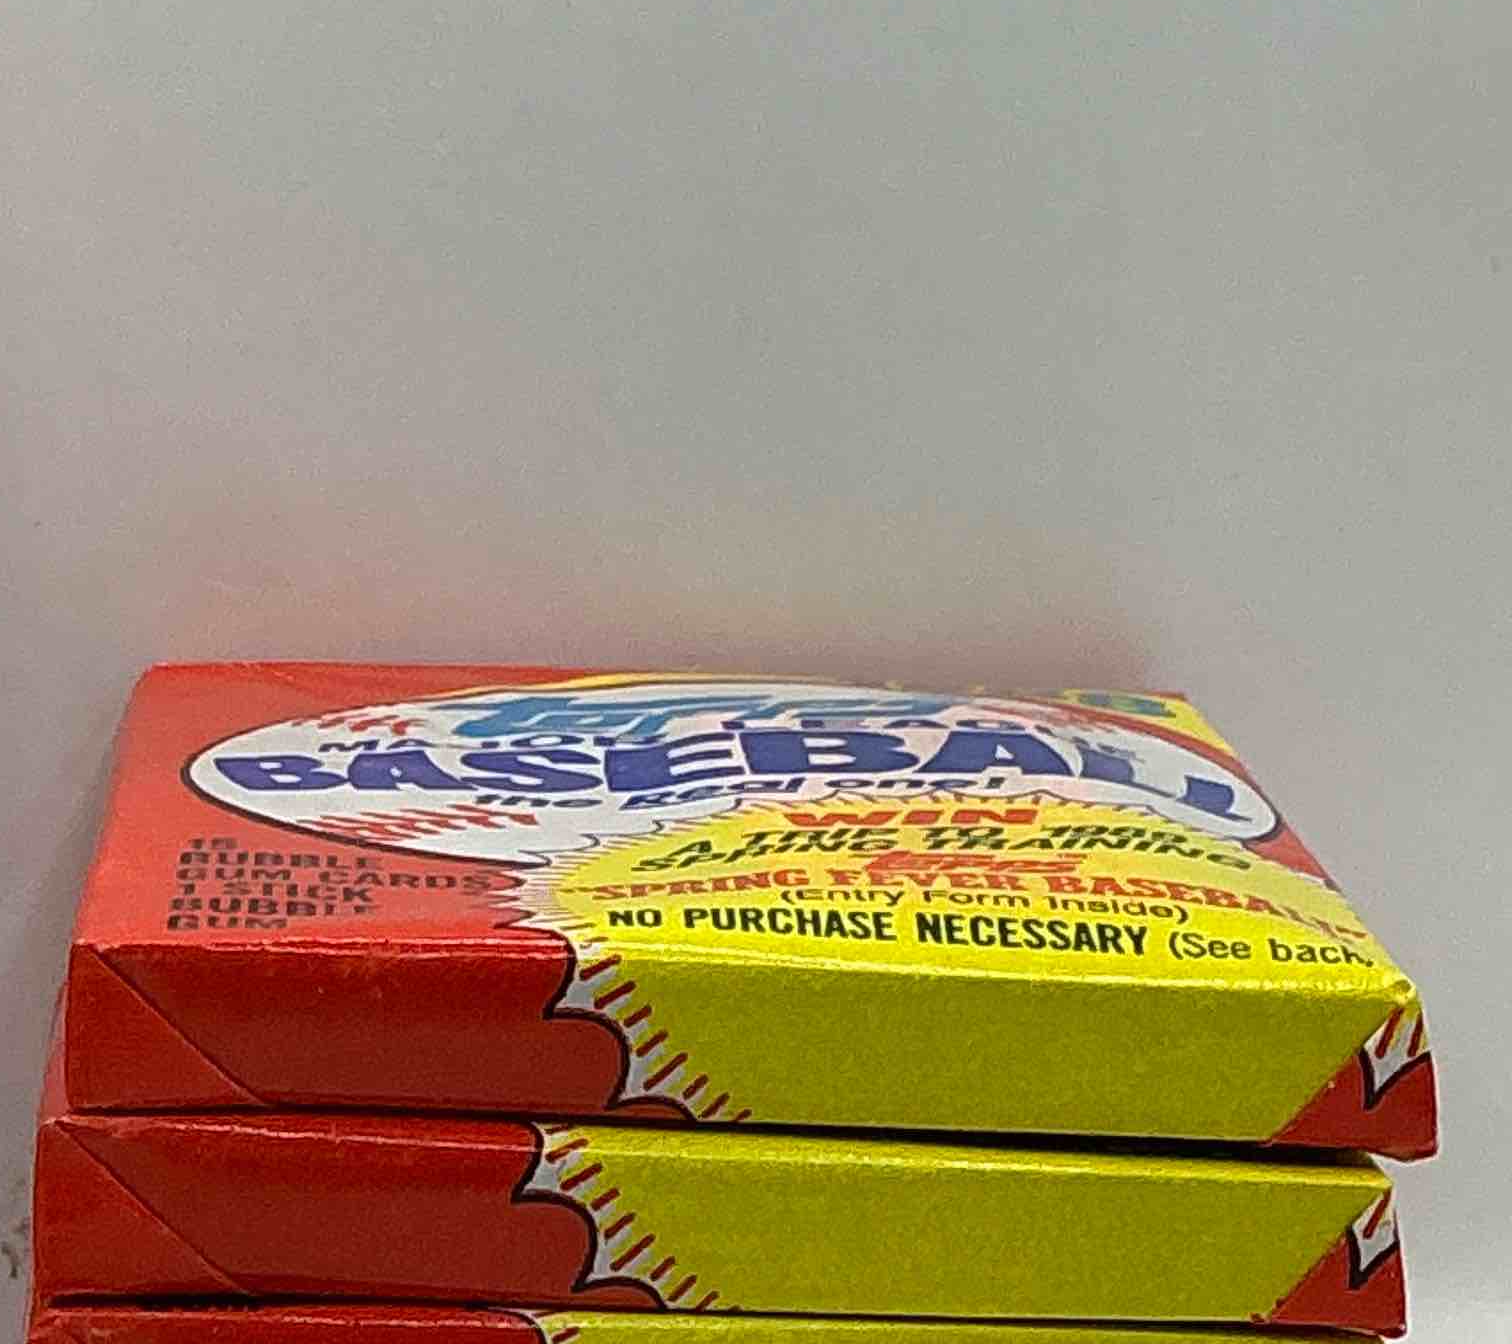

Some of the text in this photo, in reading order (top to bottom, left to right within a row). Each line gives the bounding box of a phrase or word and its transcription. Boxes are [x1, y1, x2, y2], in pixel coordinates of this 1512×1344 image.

[214, 730, 1252, 822] BASEBALL
[620, 777, 807, 810] Real
[783, 809, 1039, 826] WIN
[664, 840, 715, 855] A
[318, 870, 491, 888] CARDS
[825, 868, 1023, 890] FEVER
[780, 888, 1189, 924] (Entry Form Inside)
[607, 910, 663, 927] NO
[683, 908, 897, 940] PURCHASE
[916, 912, 1149, 956] NECESSARY
[1169, 932, 1252, 960] (See
